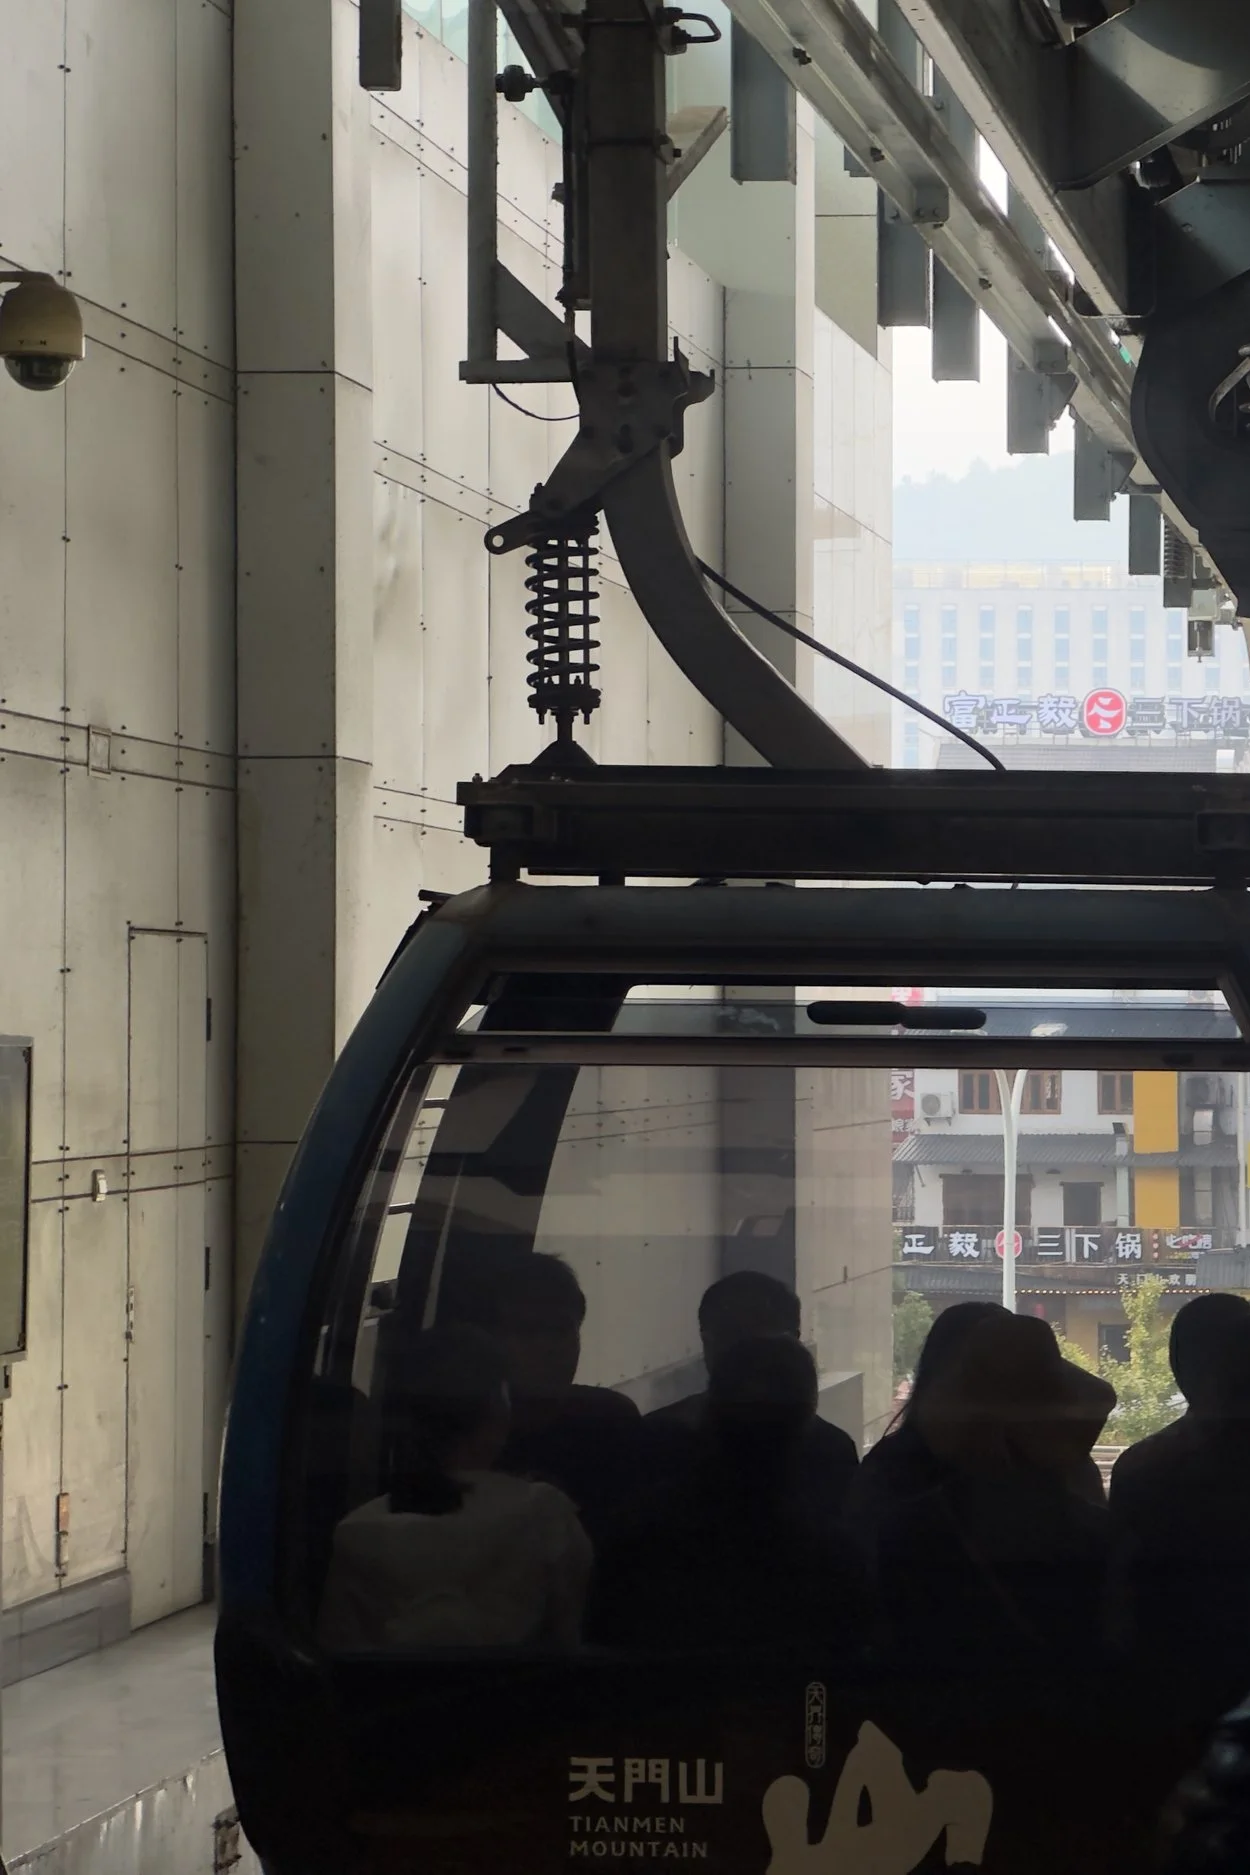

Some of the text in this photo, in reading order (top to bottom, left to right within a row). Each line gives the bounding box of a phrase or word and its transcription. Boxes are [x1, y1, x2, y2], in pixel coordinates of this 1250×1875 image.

[944, 690, 1243, 729] 富正毅 三下锅
[902, 1231, 981, 1259] 正毅
[1038, 1231, 1142, 1260] 三下锅
[568, 1757, 724, 1804] 天門山
[568, 1816, 685, 1833] TIANMEN
[570, 1840, 708, 1858] MOUNTAIN
